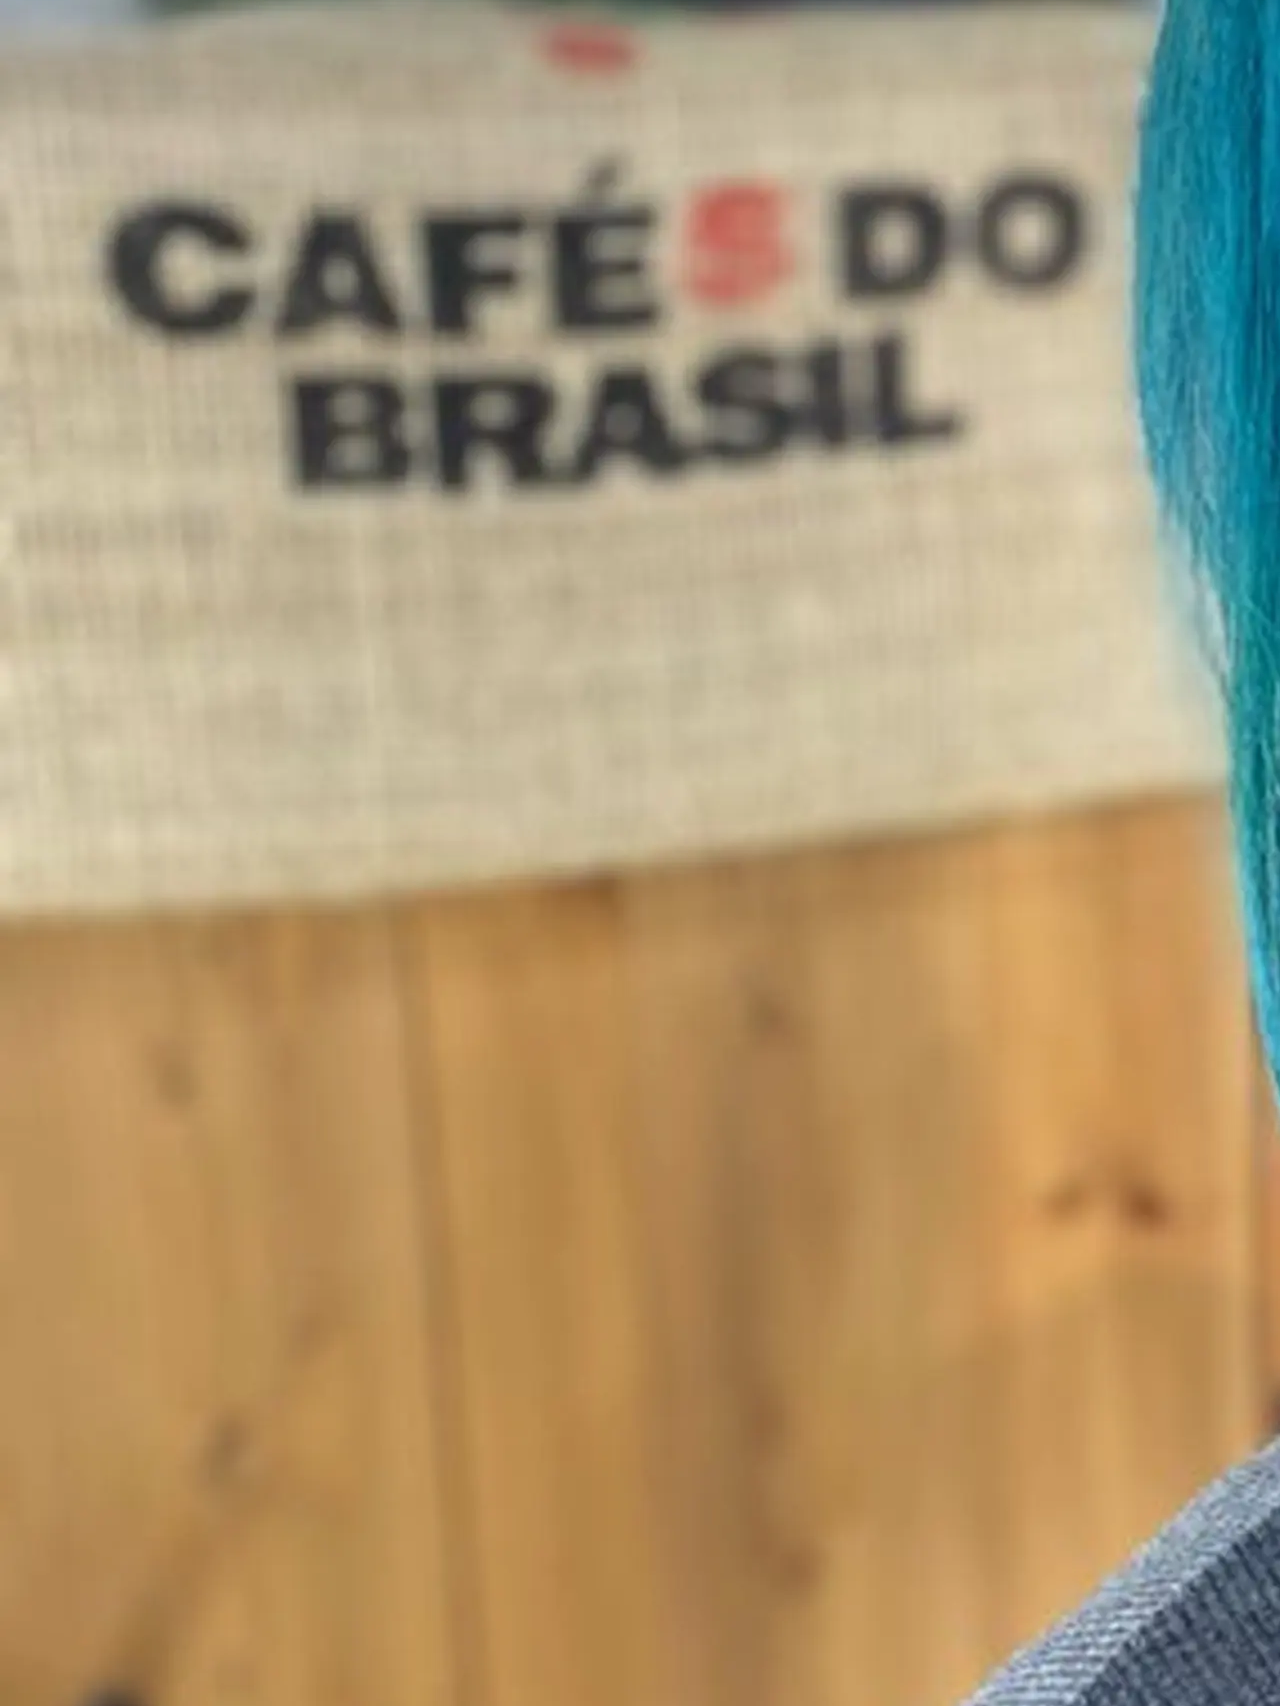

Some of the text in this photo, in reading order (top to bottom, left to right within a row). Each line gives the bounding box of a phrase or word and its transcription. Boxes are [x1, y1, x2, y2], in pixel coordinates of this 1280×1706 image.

[105, 159, 1089, 339] CAFÉS DO
[289, 333, 962, 493] BRASIL
